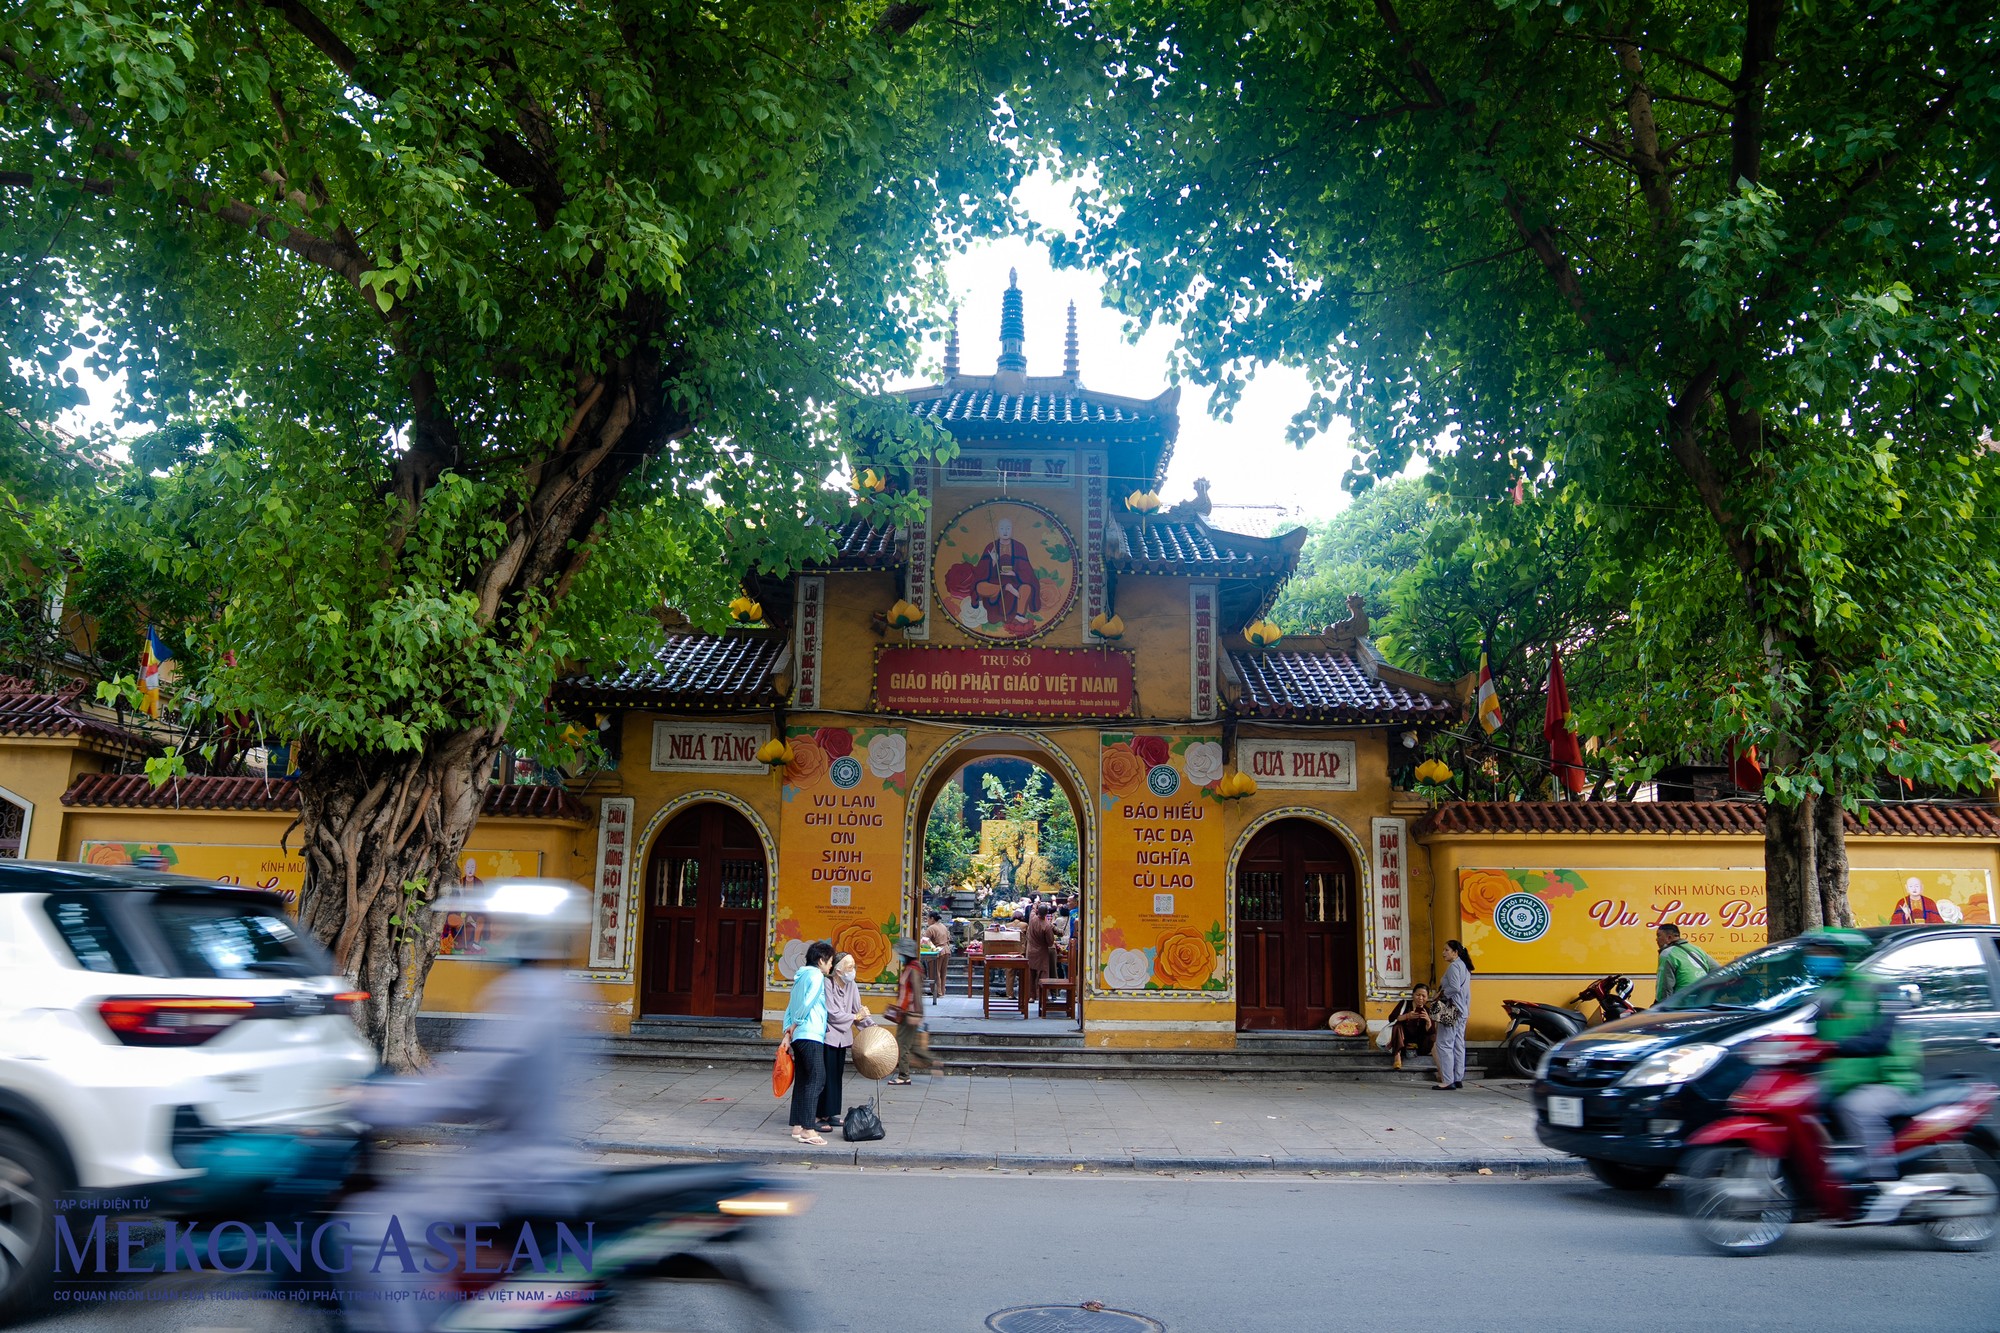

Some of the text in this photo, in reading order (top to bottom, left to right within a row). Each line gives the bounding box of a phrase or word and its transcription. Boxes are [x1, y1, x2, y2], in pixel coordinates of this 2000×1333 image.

[980, 652, 1031, 669] TRỤ SỞ
[890, 669, 1118, 695] GIÁO HỘI PHẬT GIÁO VIỆT NAM
[711, 732, 757, 762] TĂNG
[1292, 751, 1341, 778] PHÁP
[813, 794, 876, 809] VU LAN
[1123, 800, 1204, 820] BÁO HIẾU
[804, 809, 883, 827] GHI LÒNG
[830, 831, 855, 845] ƠN
[1133, 827, 1194, 846] TẠC DẠ
[821, 850, 863, 864] SINH
[1136, 848, 1191, 866] NGHĨA
[260, 860, 306, 873] KÍNH MỪ
[811, 866, 873, 883] DƯỠNG
[603, 868, 622, 888] HỘI
[1133, 870, 1194, 889] CÙ LAO
[1654, 883, 1764, 898] KÍNH MỪNG ĐẠI
[1505, 899, 1518, 908] HỘI
[1518, 898, 1537, 908] PHẬT
[1536, 908, 1544, 923] GIÁO
[1588, 899, 1768, 929] Vu Lan Bá
[1507, 927, 1538, 937] VIỆT NAM
[1383, 935, 1401, 953] PHẬT
[1386, 953, 1400, 972] ẤN
